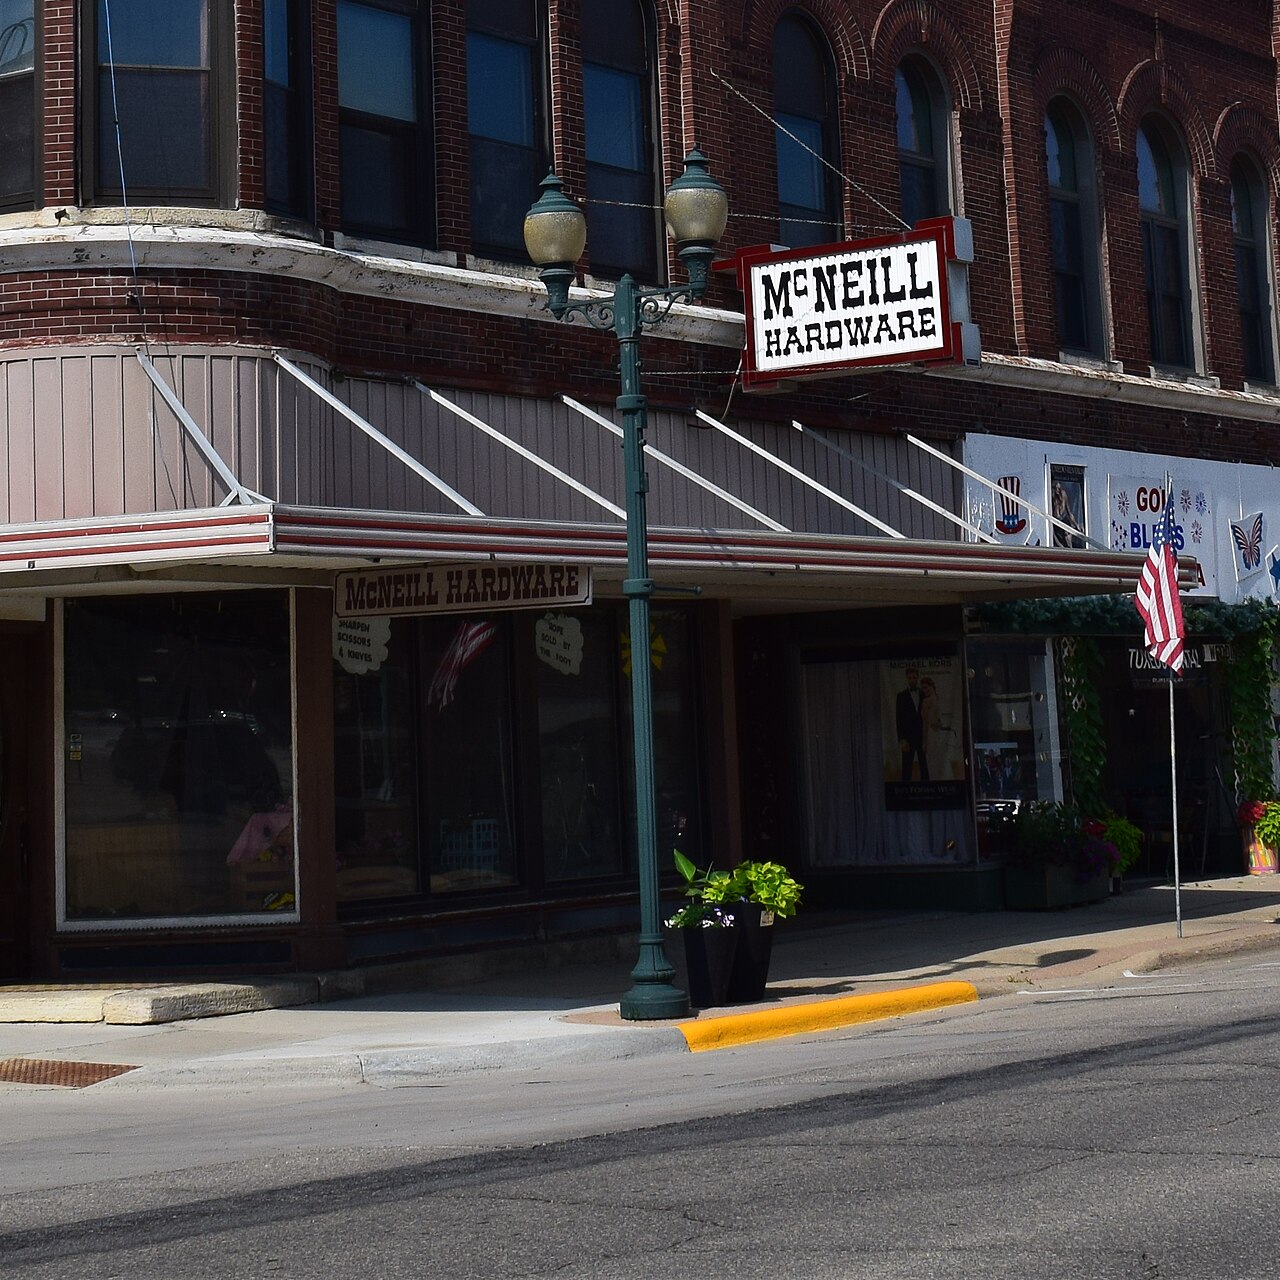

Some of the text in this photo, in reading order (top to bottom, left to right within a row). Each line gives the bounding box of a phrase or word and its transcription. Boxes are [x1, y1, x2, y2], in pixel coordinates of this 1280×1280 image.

[765, 307, 936, 357] HARDWARE
[1130, 522, 1185, 551] BLS
[446, 565, 579, 604] HARDWARE
[339, 620, 370, 632] SHARPEN
[549, 622, 564, 635] ROPE
[337, 632, 372, 647] SCISSORS
[541, 633, 557, 645] SOLD
[347, 649, 373, 662] KNIVES
[540, 646, 572, 667] THE FOOT
[928, 659, 952, 668] KORS
